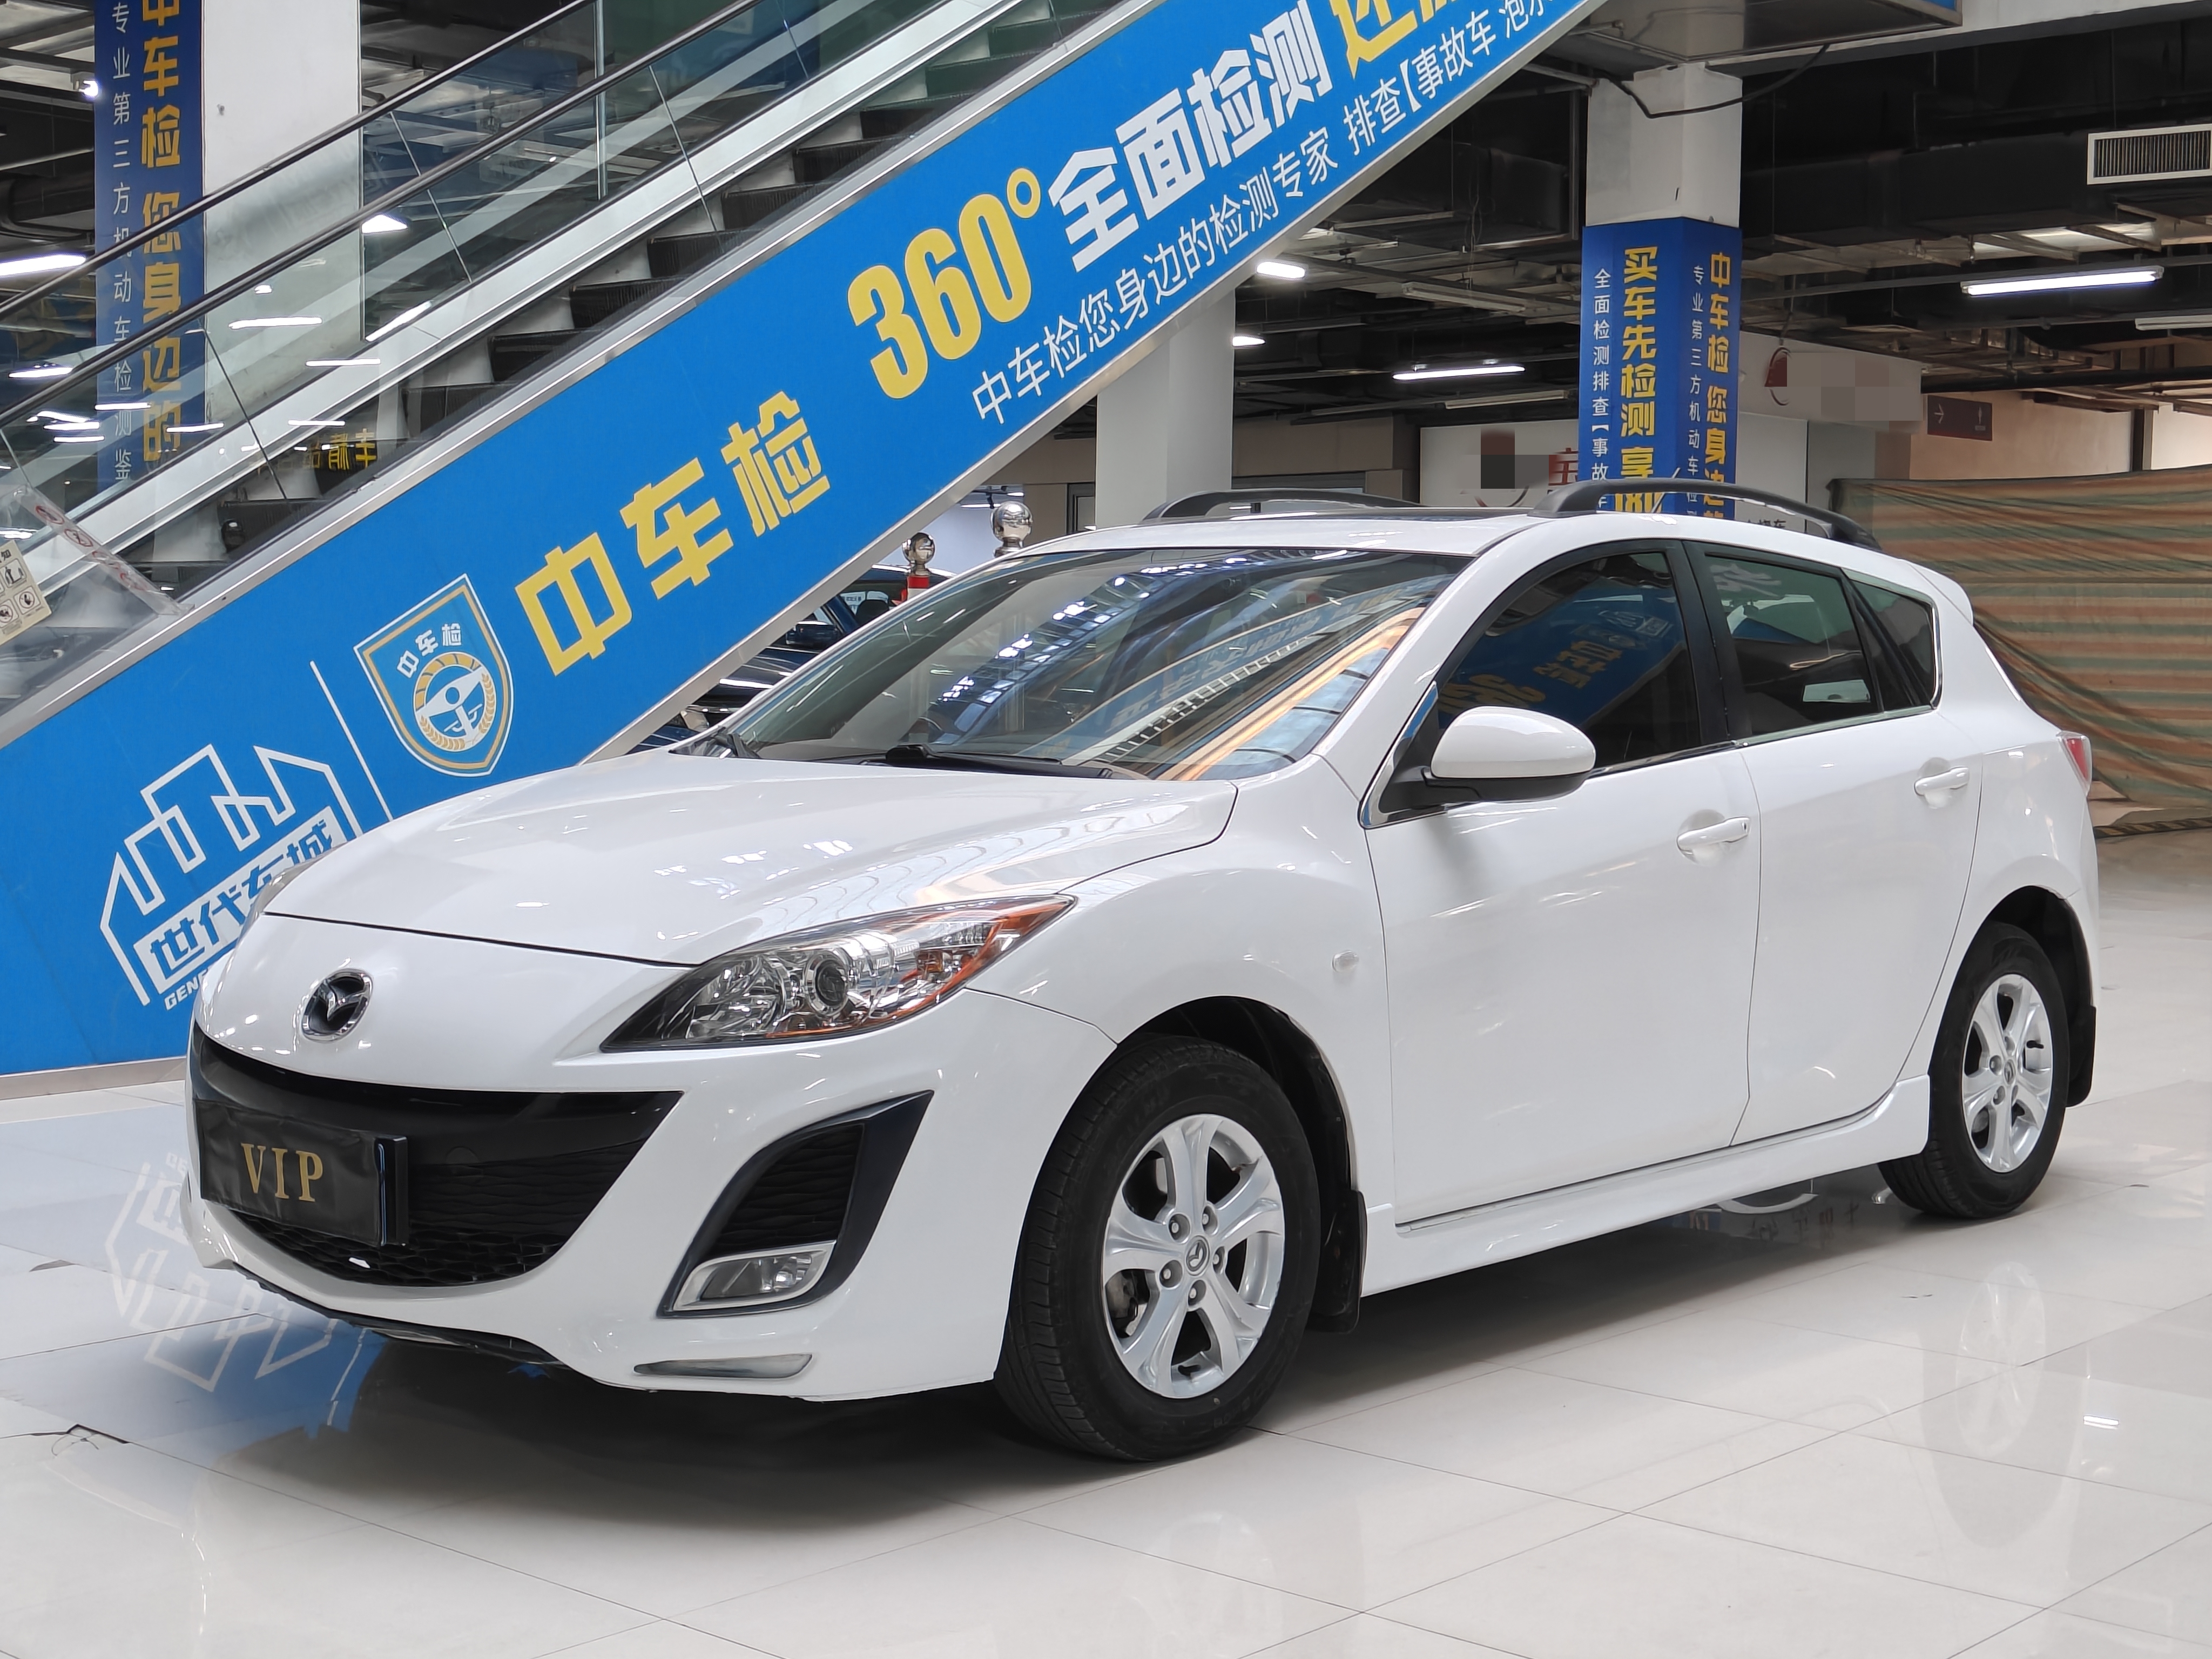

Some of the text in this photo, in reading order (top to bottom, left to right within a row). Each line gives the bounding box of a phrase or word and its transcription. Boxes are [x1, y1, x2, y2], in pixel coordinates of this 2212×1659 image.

[142, 192, 181, 461] 您身边的
[972, 127, 1338, 424] 中车检您身边的检测专家
[1620, 246, 1658, 437] 买车先检测
[1686, 266, 1704, 515] 专业第三方机动车
[1703, 252, 1731, 518] 中车检 您身边
[396, 623, 462, 678] 中车检
[515, 391, 830, 676] 中车检
[241, 1143, 323, 1202] VIP
